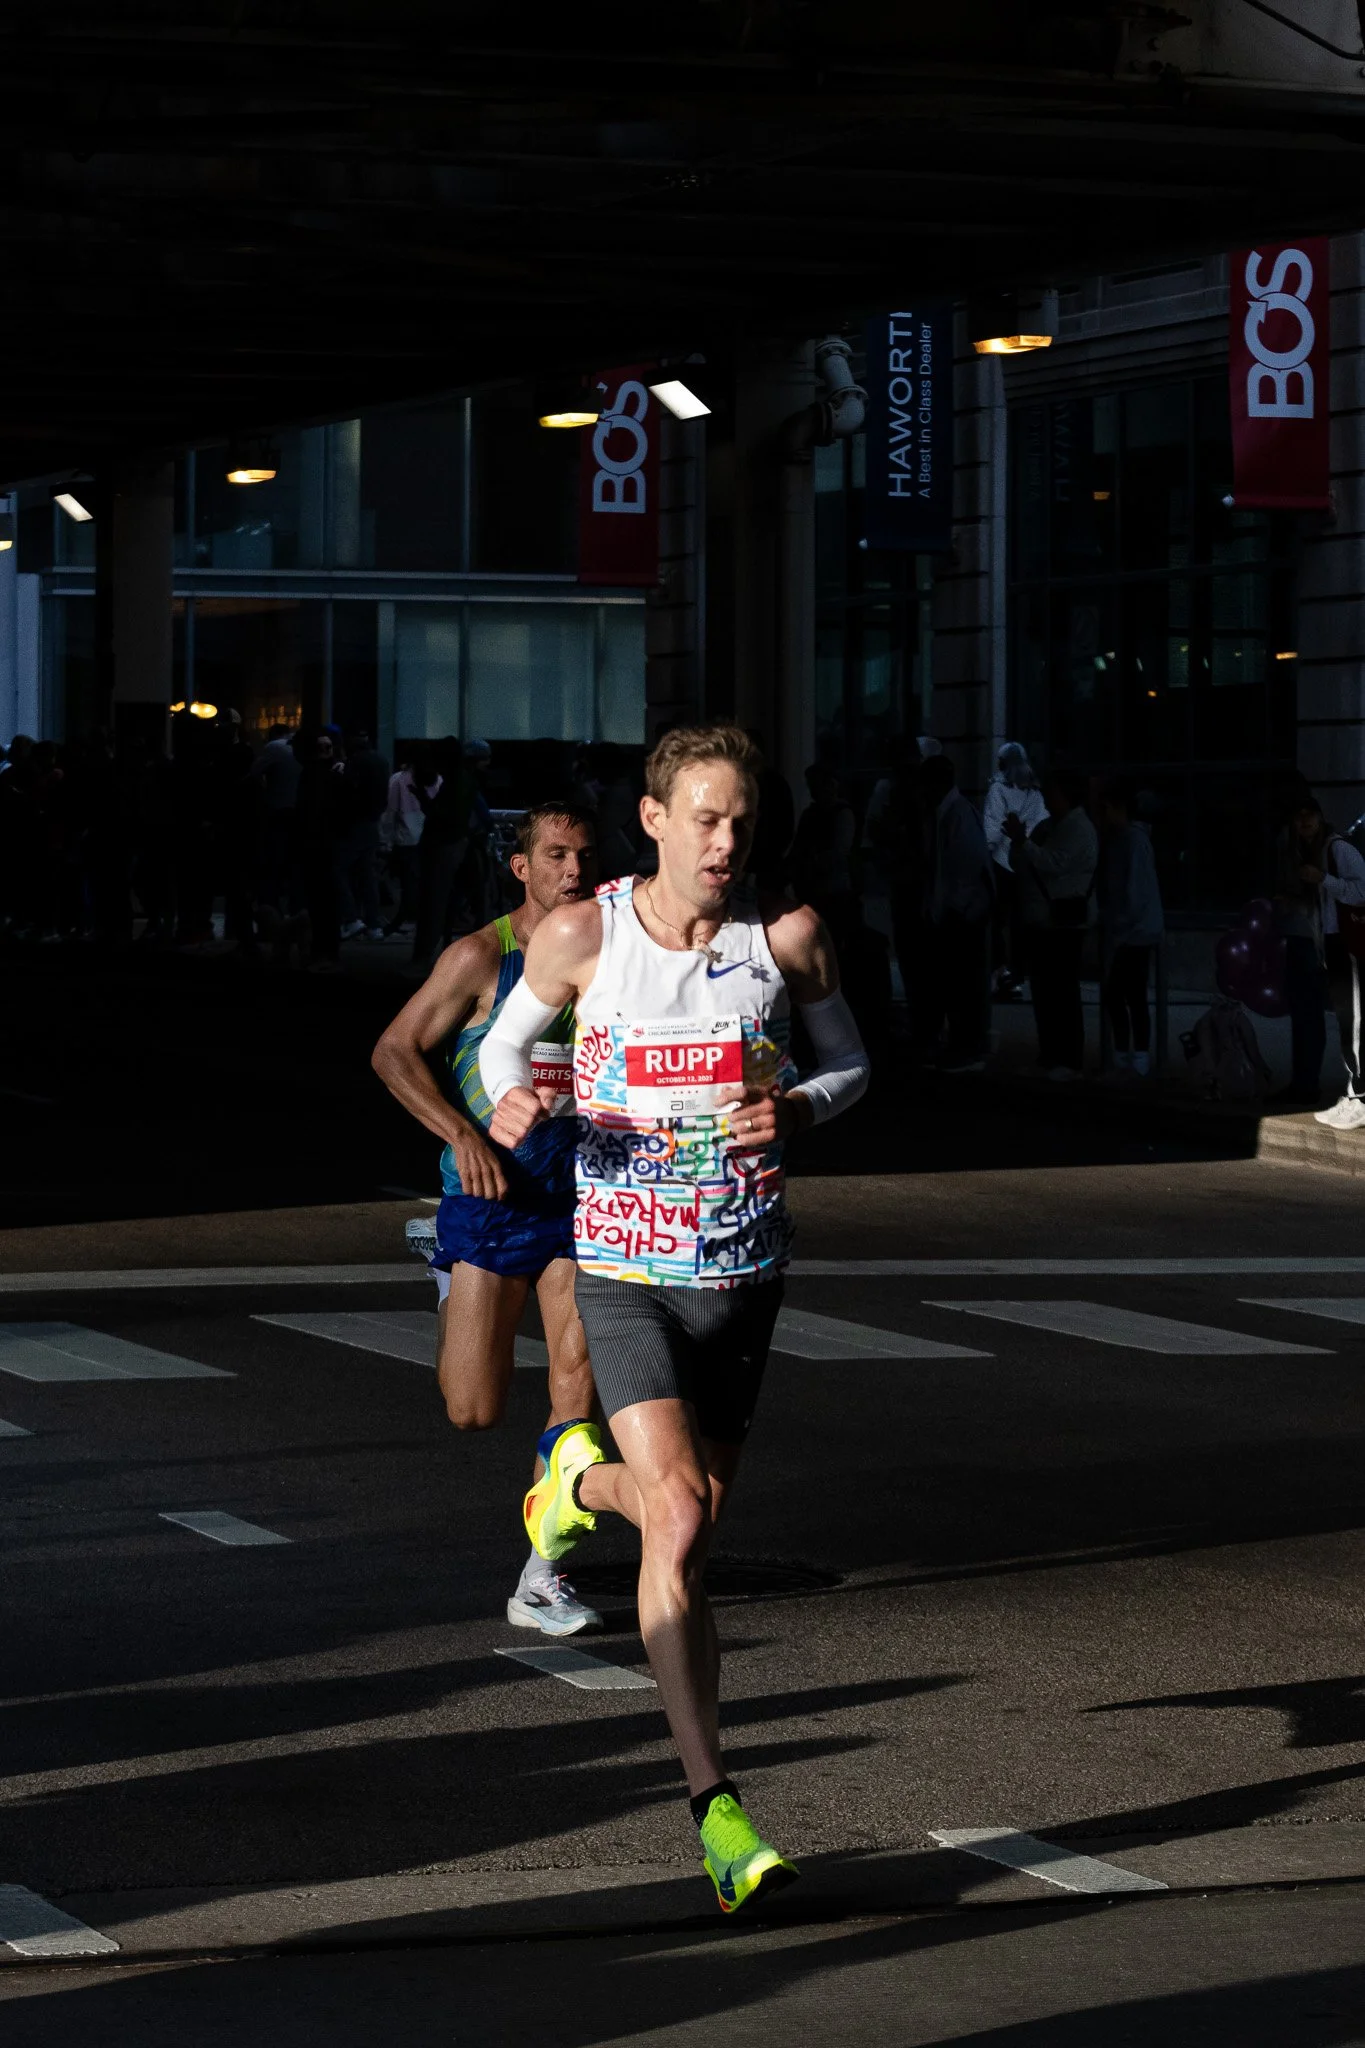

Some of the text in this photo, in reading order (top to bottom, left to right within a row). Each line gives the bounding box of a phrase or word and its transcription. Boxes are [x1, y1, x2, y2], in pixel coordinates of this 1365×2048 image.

[1244, 248, 1316, 419] BOS
[591, 380, 649, 514] BOS
[918, 322, 931, 499] A Best in Class Dealer
[645, 1046, 724, 1073] RUPP
[656, 1076, 686, 1084] OCTOBER
[698, 1074, 714, 1083] 2025
